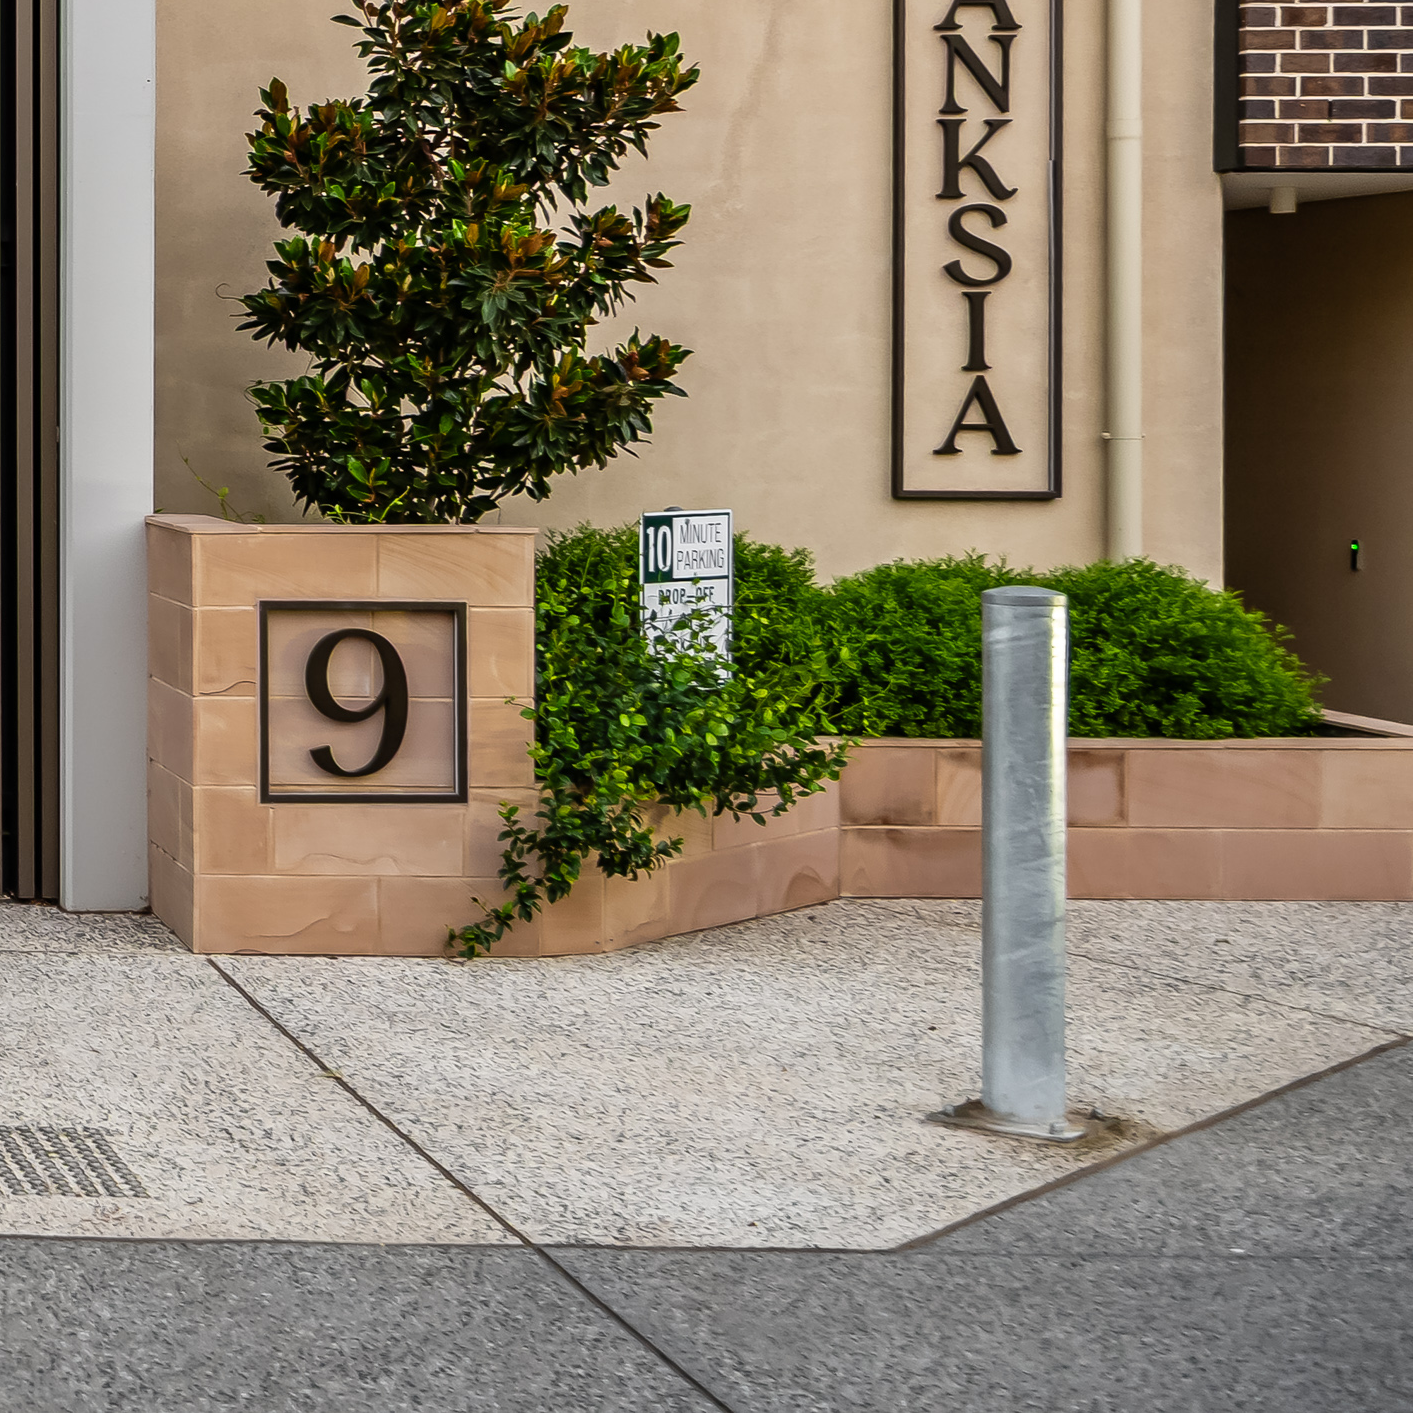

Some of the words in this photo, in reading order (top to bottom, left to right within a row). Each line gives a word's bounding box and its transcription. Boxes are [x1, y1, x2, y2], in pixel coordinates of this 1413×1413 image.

[646, 525, 672, 573] 10
[680, 523, 722, 544] MINUTE
[676, 548, 725, 570] PARKING
[305, 627, 409, 777] 9
